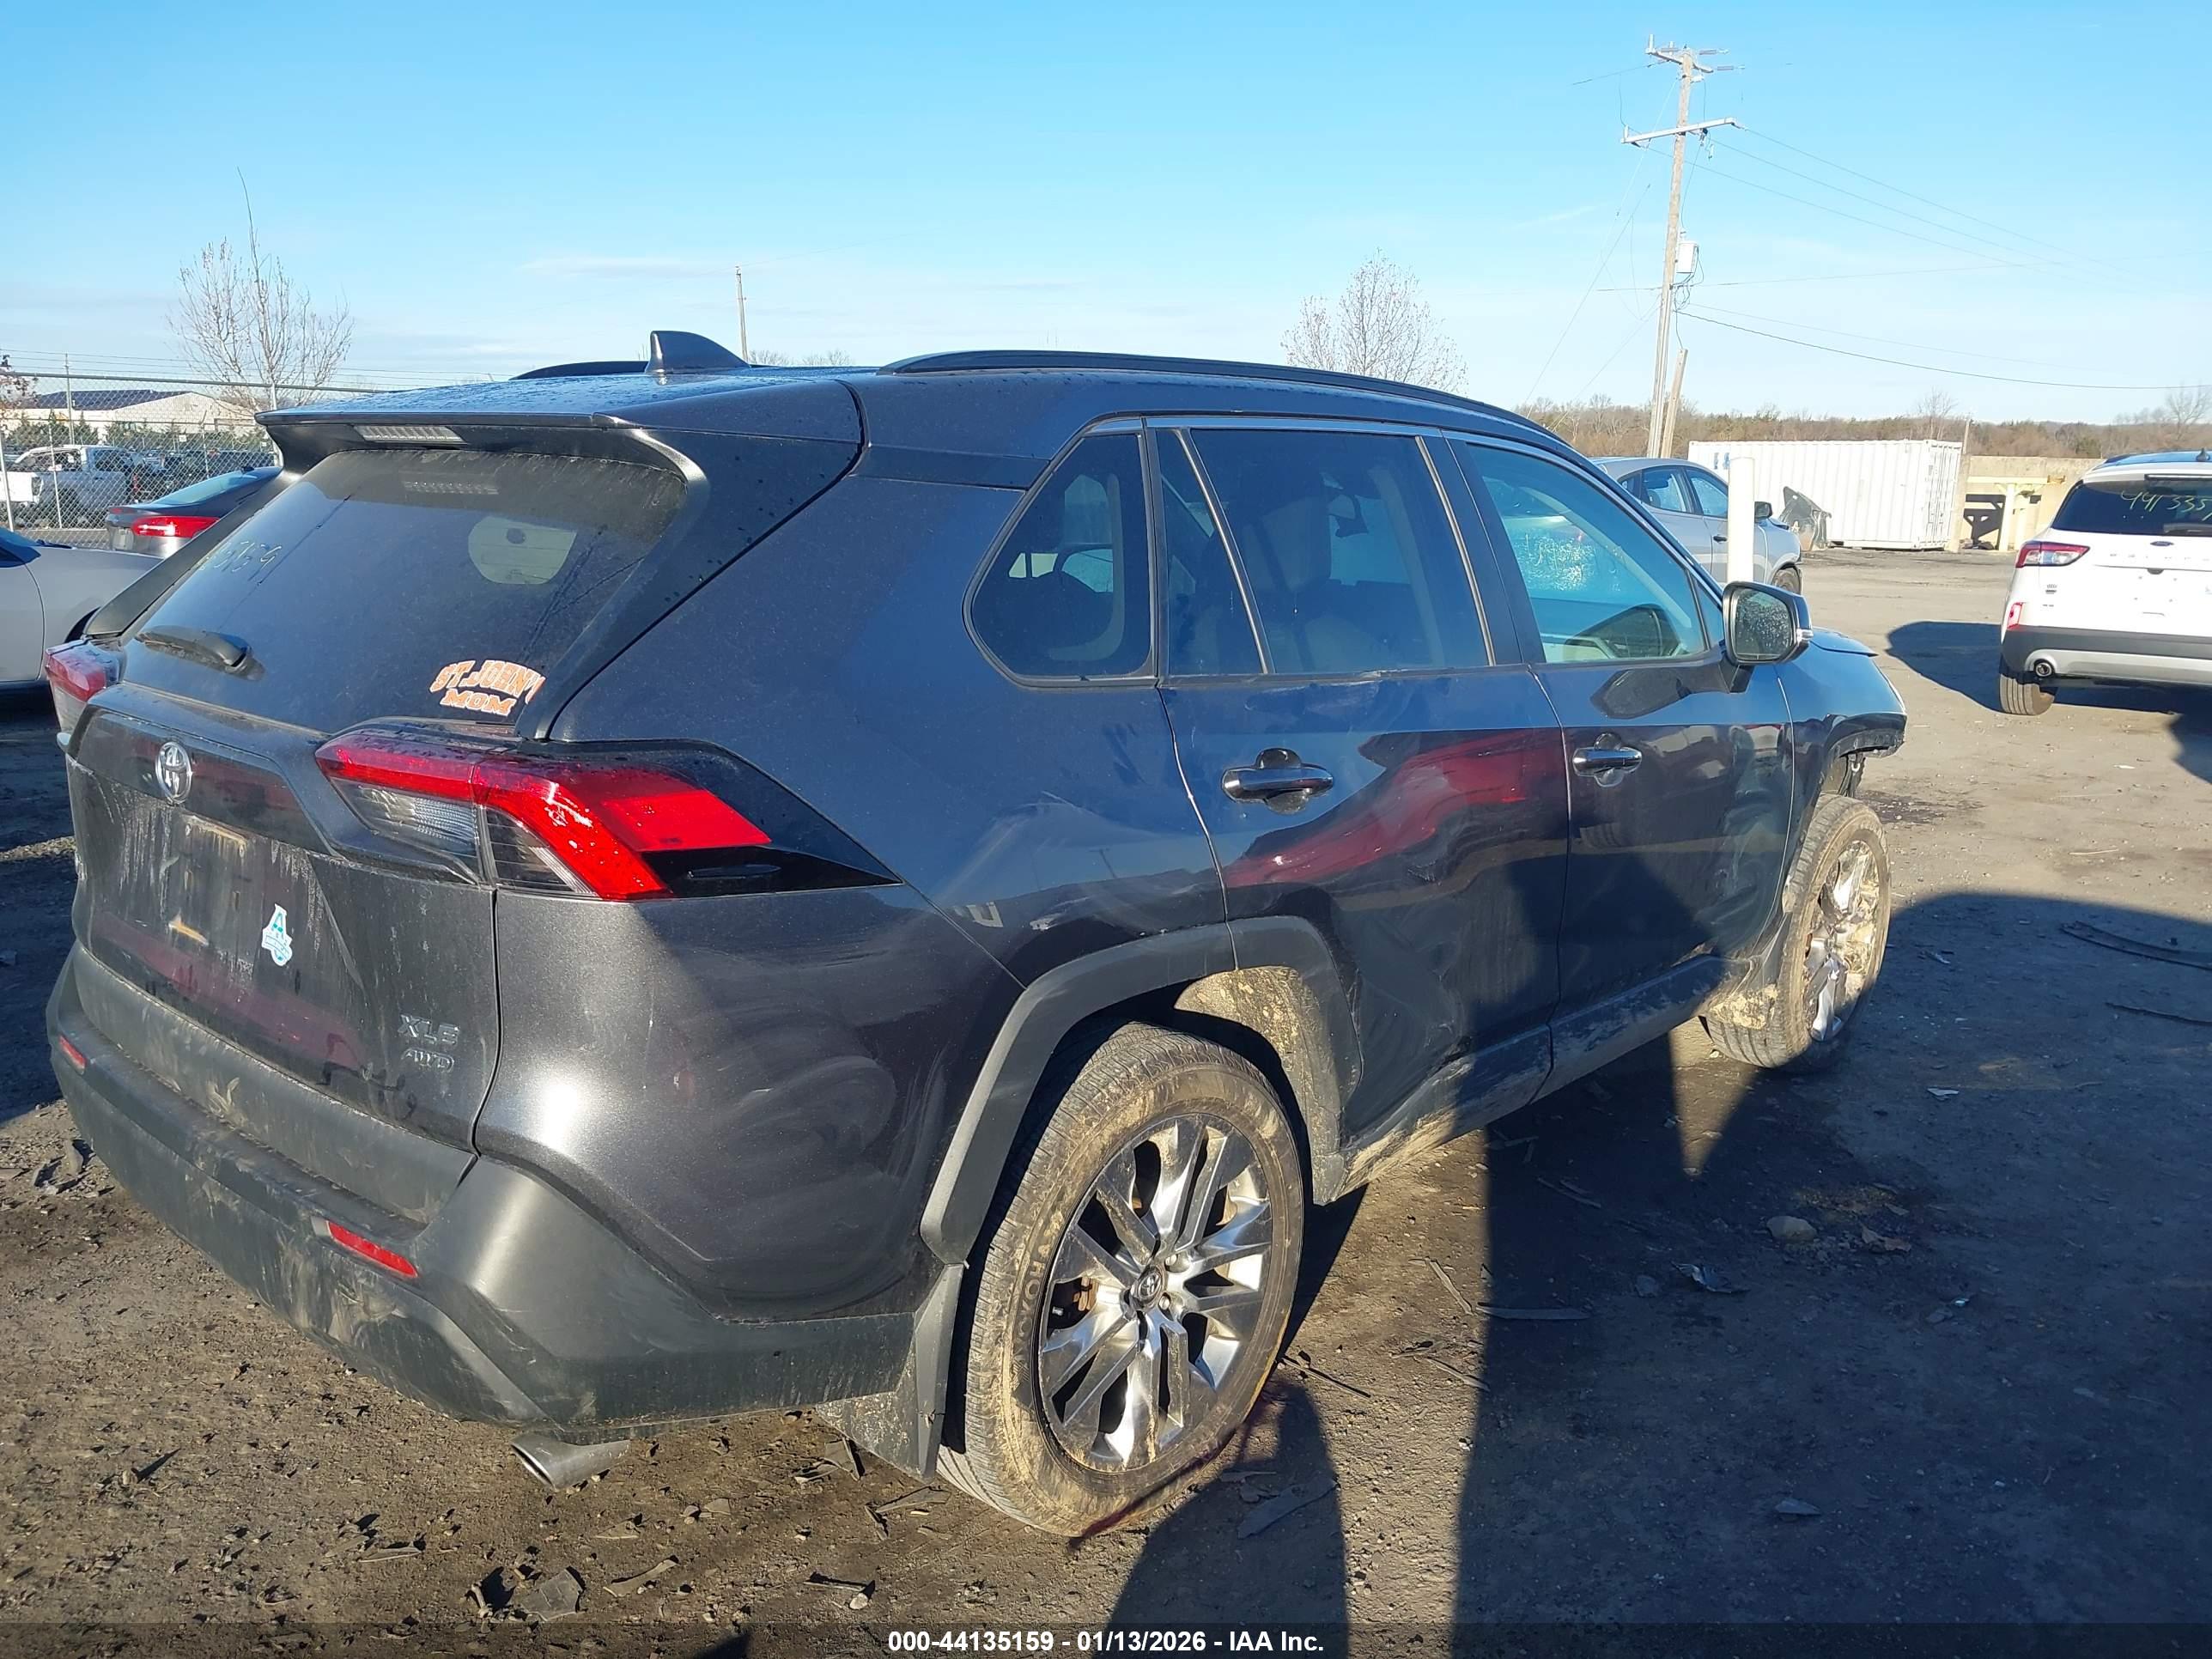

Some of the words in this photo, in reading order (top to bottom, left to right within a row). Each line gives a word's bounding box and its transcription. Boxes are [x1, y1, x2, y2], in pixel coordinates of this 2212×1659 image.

[440, 689, 517, 716] MOM
[397, 1013, 459, 1046] XLE
[400, 1047, 455, 1073] AWD
